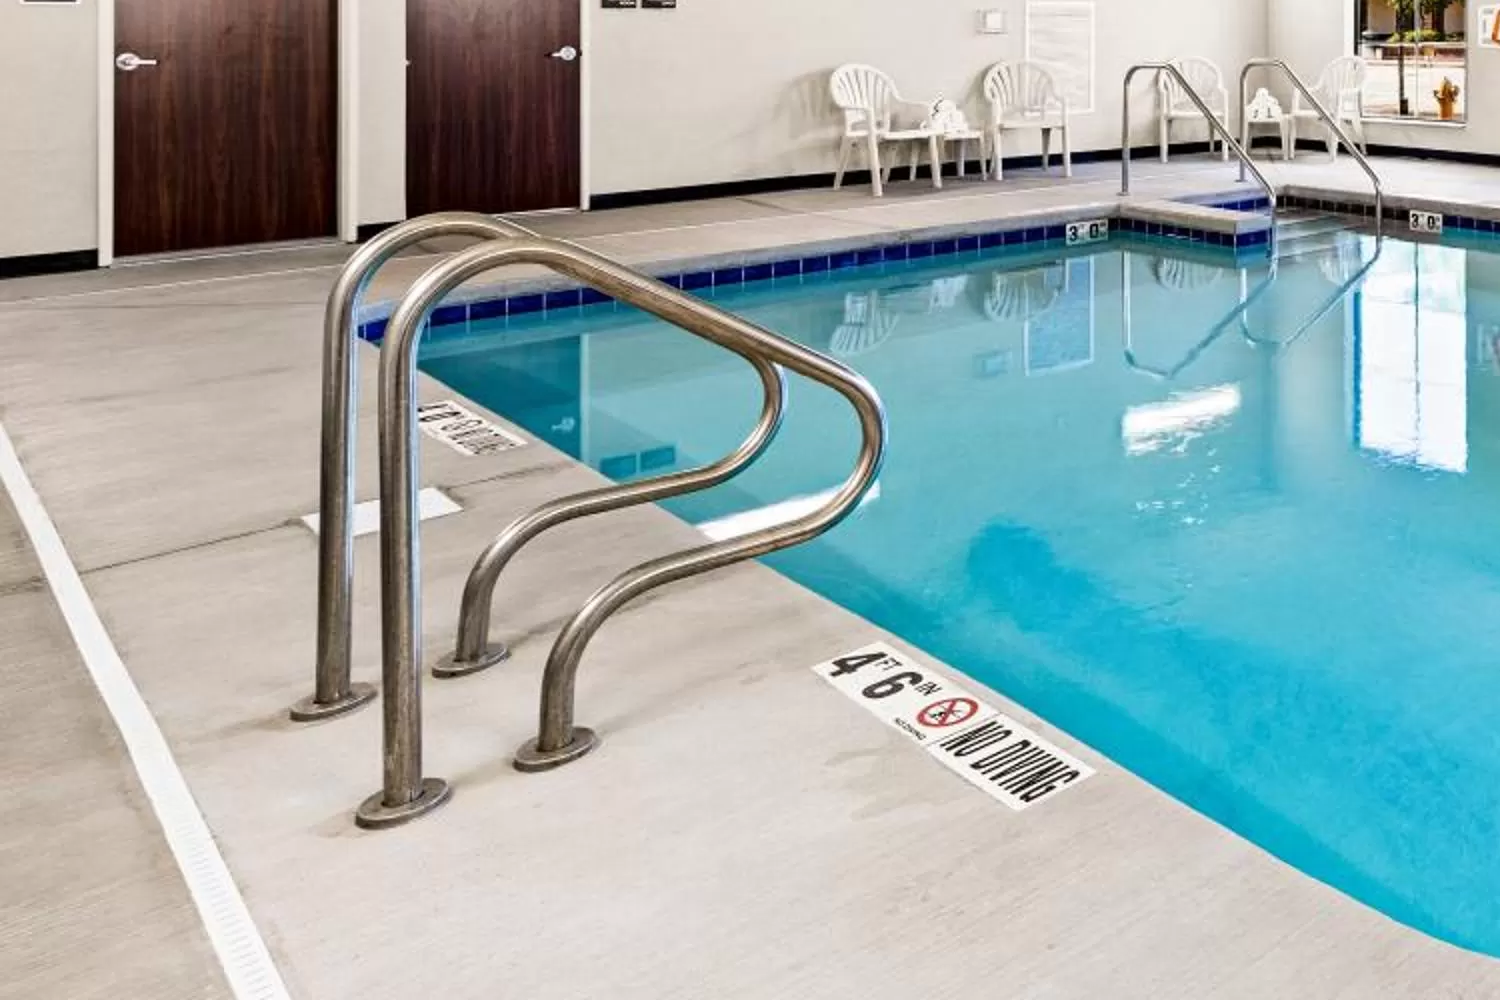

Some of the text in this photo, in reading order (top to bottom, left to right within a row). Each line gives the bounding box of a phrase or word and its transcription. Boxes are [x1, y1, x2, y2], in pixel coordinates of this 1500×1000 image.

[830, 652, 888, 676] 4
[862, 671, 923, 699] 6
[939, 720, 1080, 802] NO DIVING
